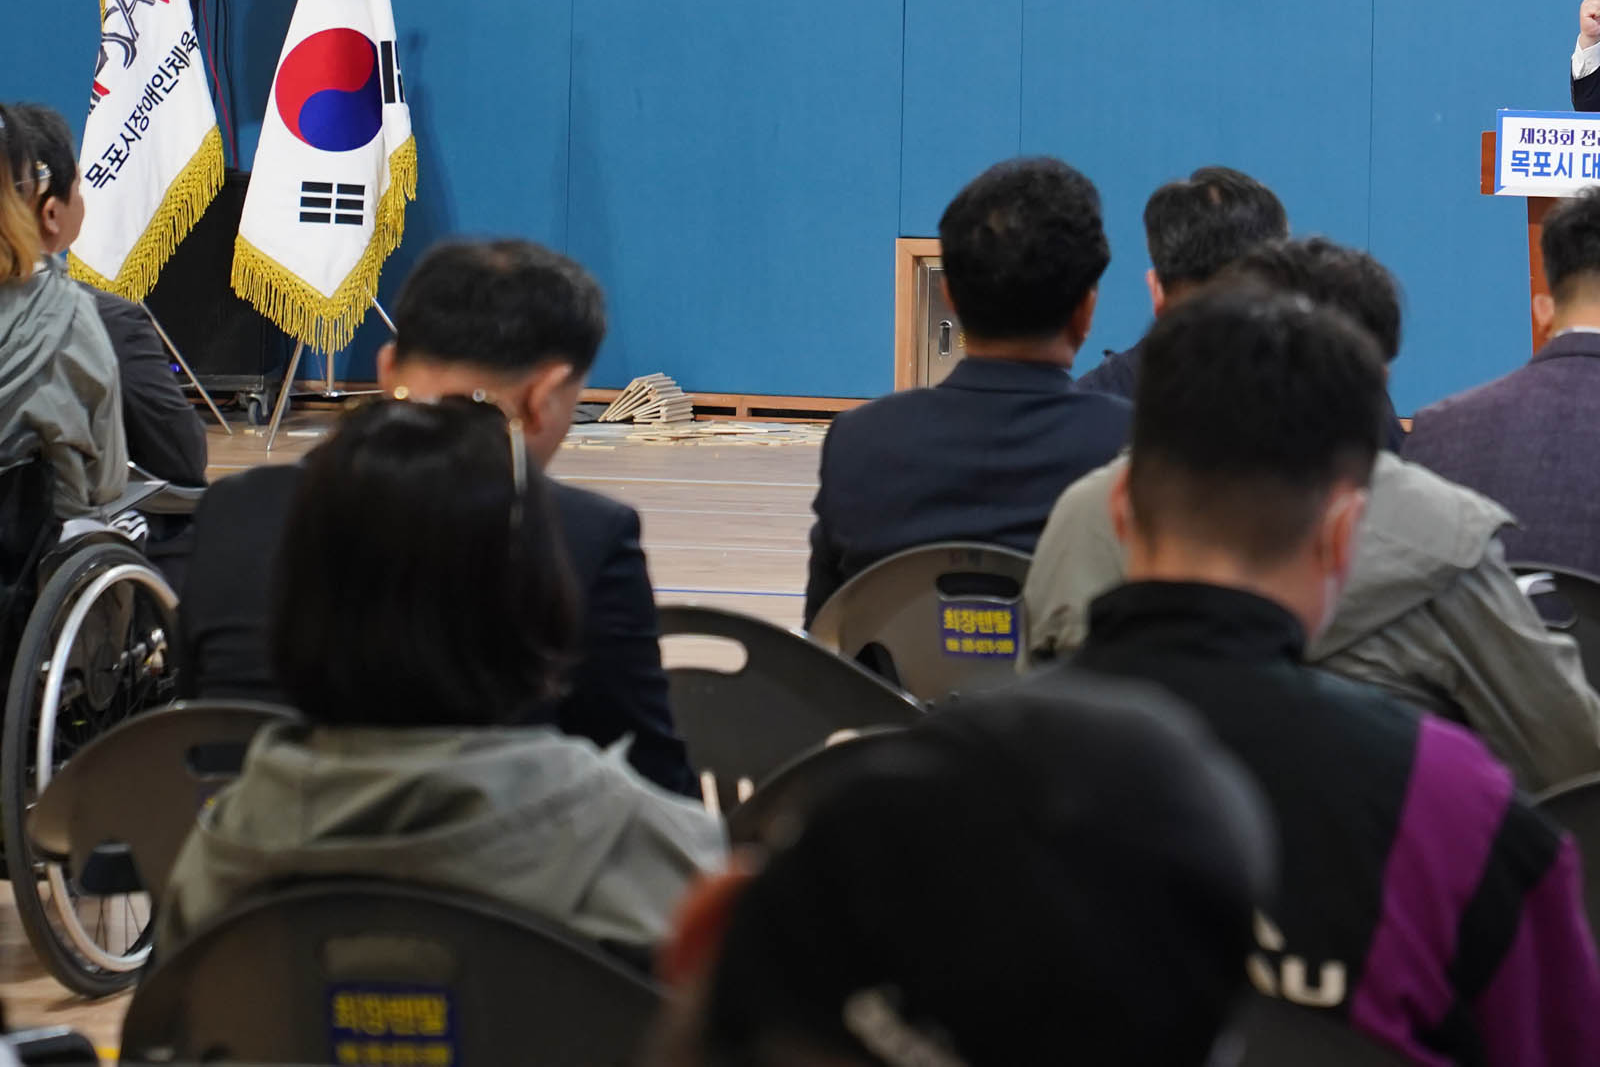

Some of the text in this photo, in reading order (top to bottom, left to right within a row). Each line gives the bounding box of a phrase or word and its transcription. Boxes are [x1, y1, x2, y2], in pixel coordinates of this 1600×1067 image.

[85, 30, 200, 190] 목포시장애인체육
[1518, 127, 1575, 147] 제33회
[1510, 149, 1574, 179] 목포시
